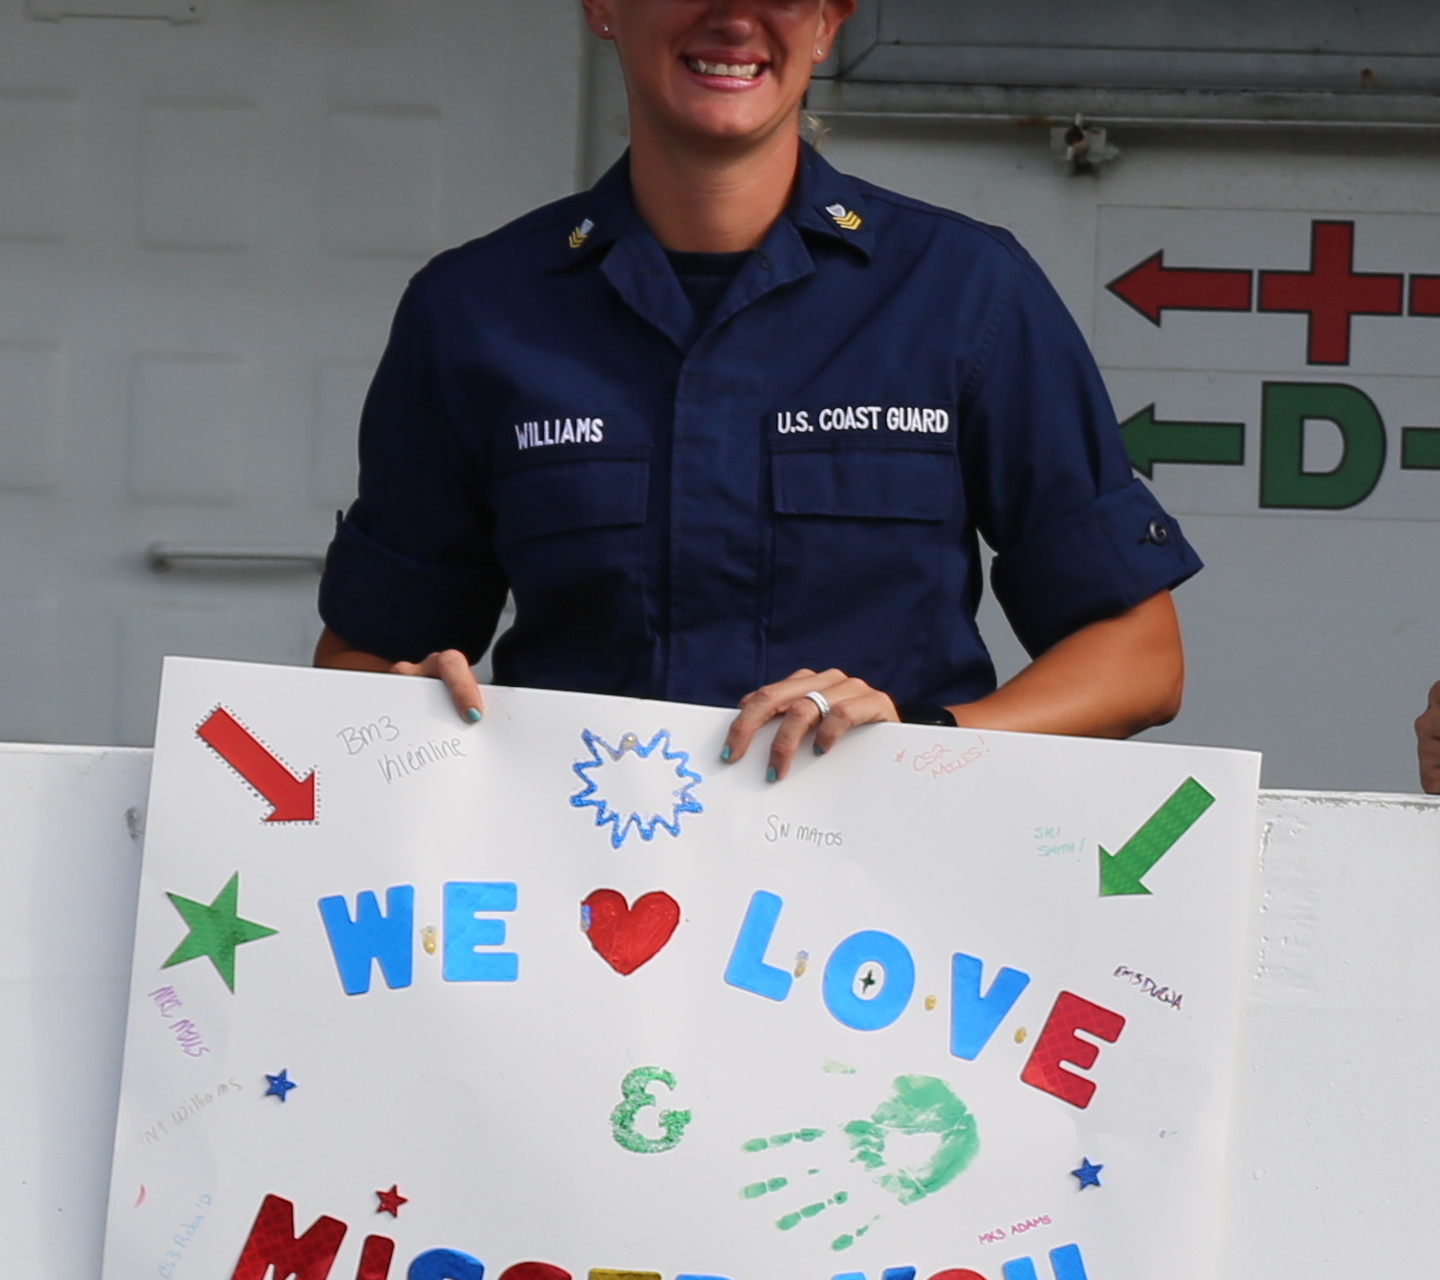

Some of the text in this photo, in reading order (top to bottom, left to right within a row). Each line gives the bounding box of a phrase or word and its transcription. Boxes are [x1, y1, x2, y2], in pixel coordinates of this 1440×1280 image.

[514, 418, 604, 450] WILLIAMS
[777, 405, 950, 434] U.S. COAST GUARD
[1258, 381, 1387, 511] D
[763, 814, 845, 849] SN MATOS
[318, 880, 1127, 1110] WE LOVE
[609, 1065, 691, 1155] &
[977, 1214, 1053, 1245] MK3 ADAMS
